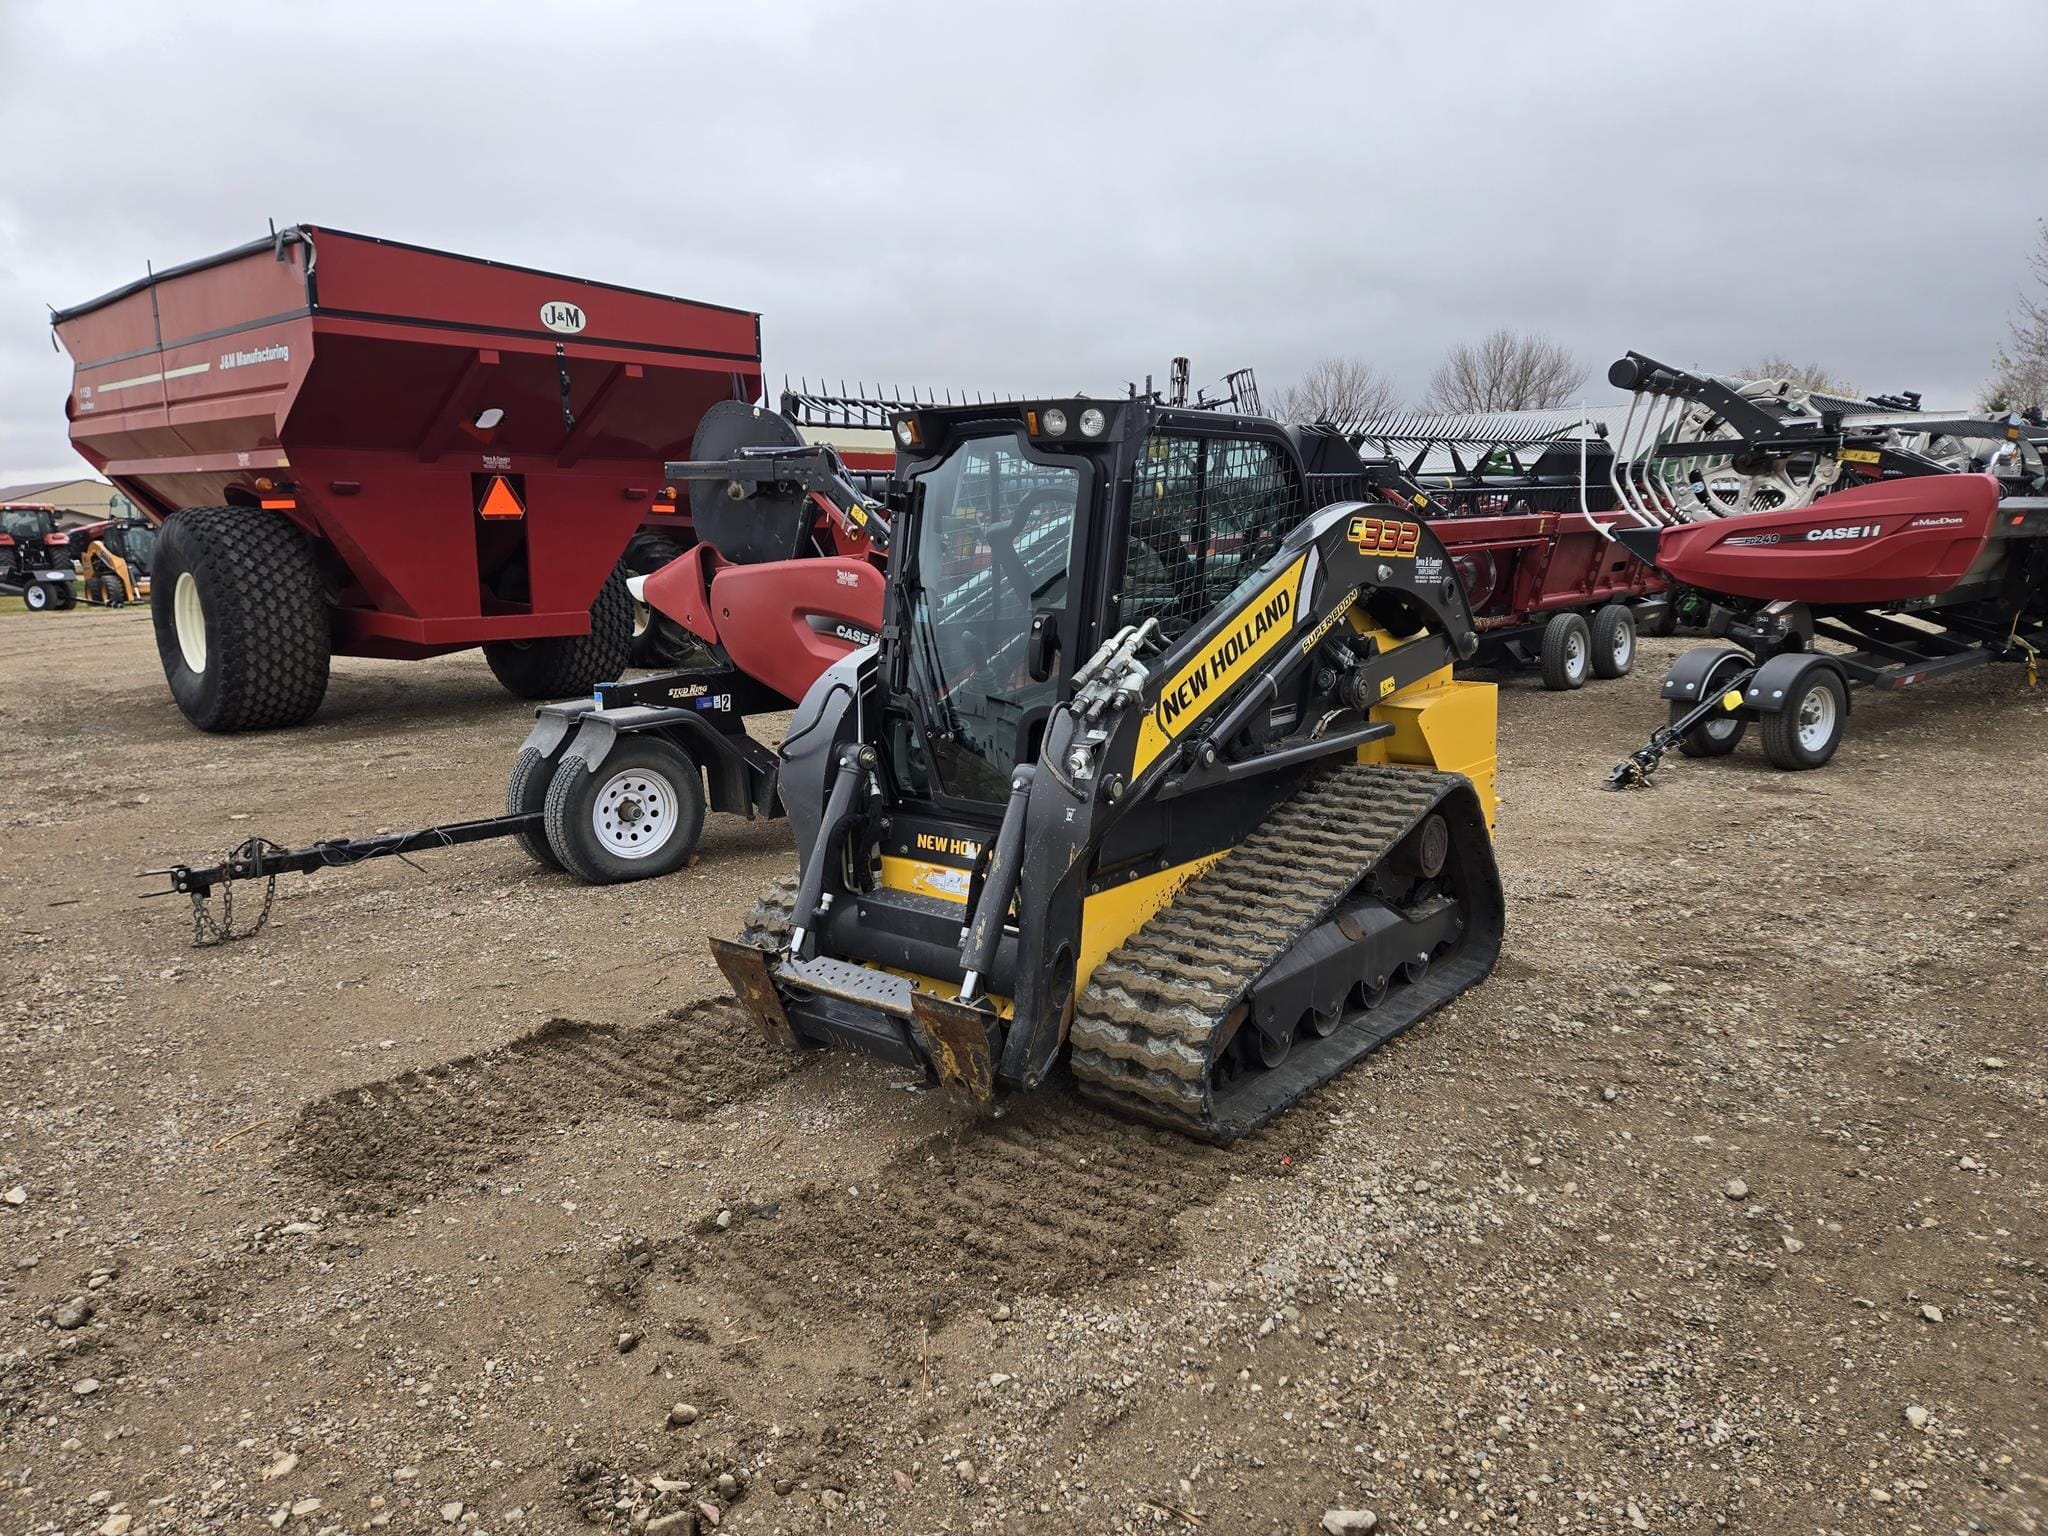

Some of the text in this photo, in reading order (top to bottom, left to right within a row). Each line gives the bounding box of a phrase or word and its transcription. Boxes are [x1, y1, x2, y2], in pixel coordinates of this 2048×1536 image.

[544, 305, 580, 328] J&M
[219, 343, 289, 370] J&M Manufacturing
[1919, 516, 1963, 526] MacDon
[1807, 526, 1861, 541] CASE
[1302, 588, 1358, 653] SUPER BOOM
[836, 625, 870, 645] CASE
[1162, 588, 1290, 724] NEW HOLLAND
[722, 695, 731, 711] 2
[917, 833, 948, 853] NEW
